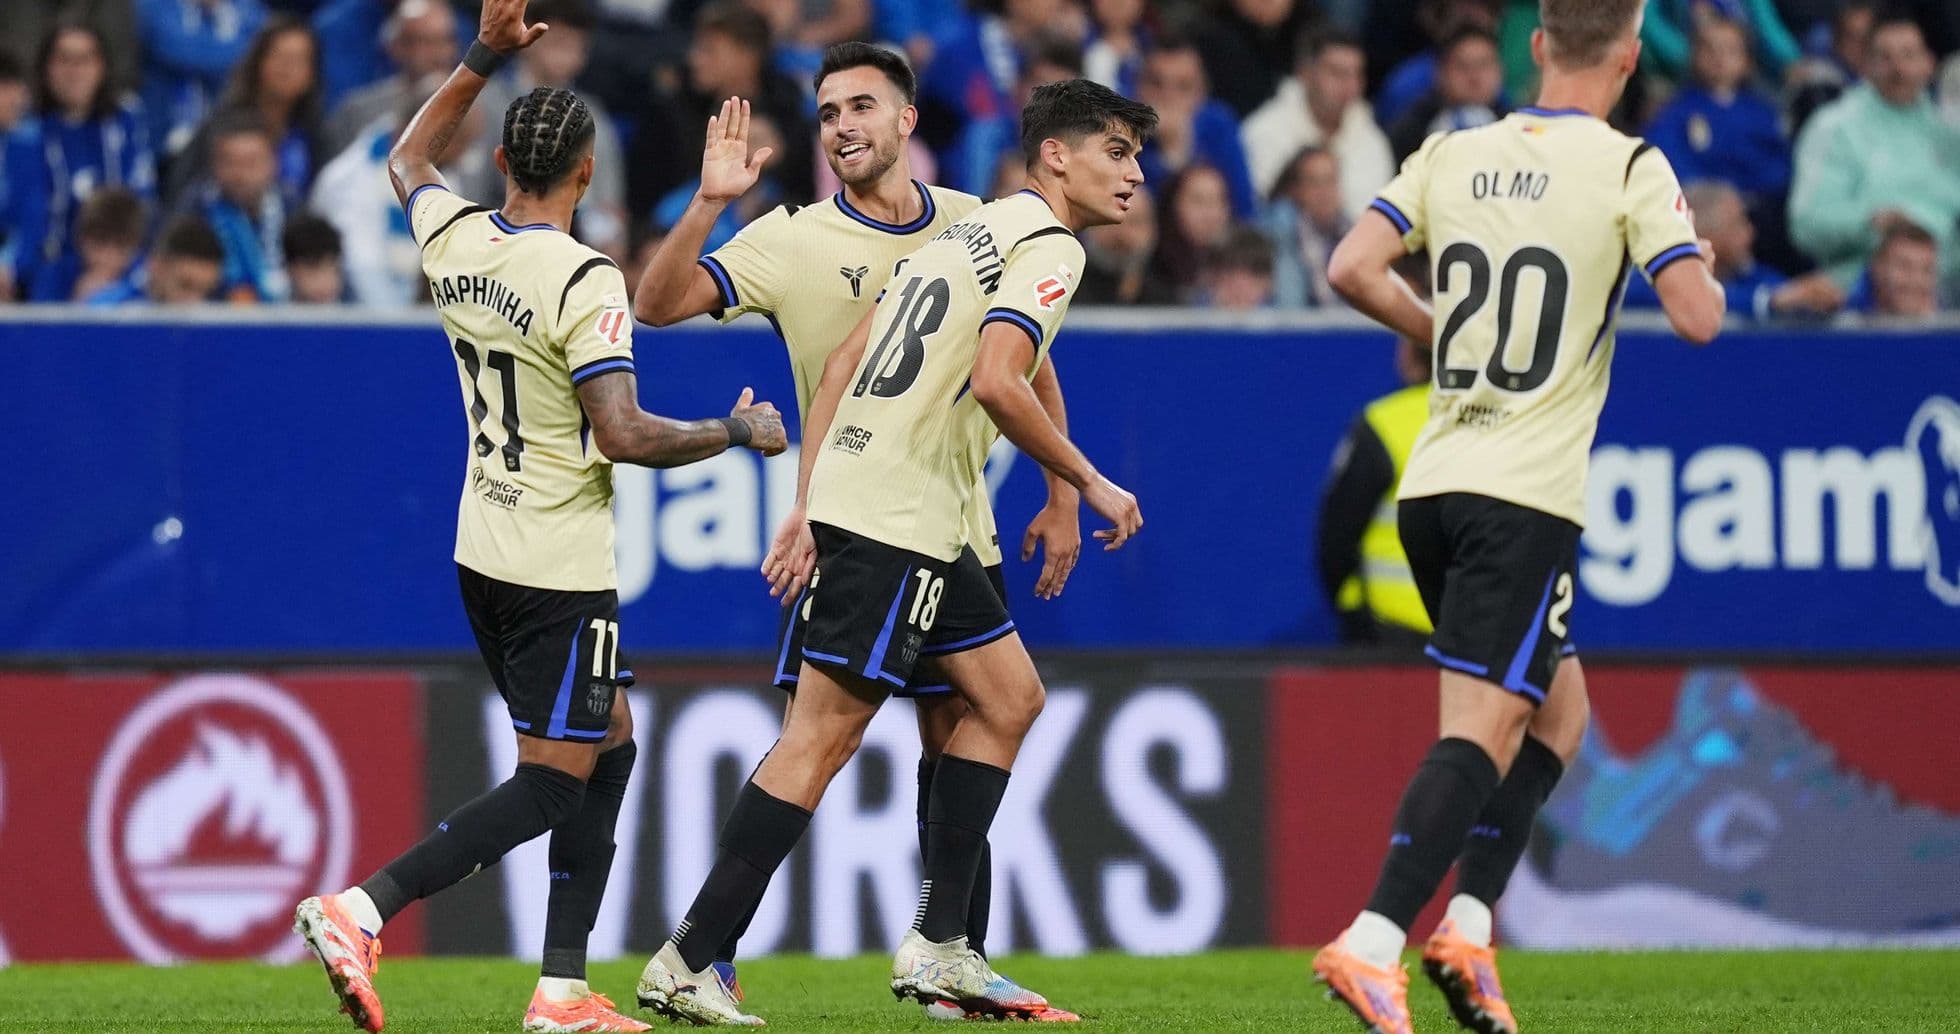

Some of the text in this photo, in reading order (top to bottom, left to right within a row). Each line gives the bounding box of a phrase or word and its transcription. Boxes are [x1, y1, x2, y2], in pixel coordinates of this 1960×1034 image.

[1472, 170, 1550, 200] OLMO
[431, 274, 535, 337] RAPHINHA
[852, 276, 951, 398] 18
[1436, 241, 1569, 393] 20
[454, 337, 525, 472] 11
[1578, 443, 1927, 607] gam
[908, 568, 944, 632] 18
[590, 618, 618, 680] 11
